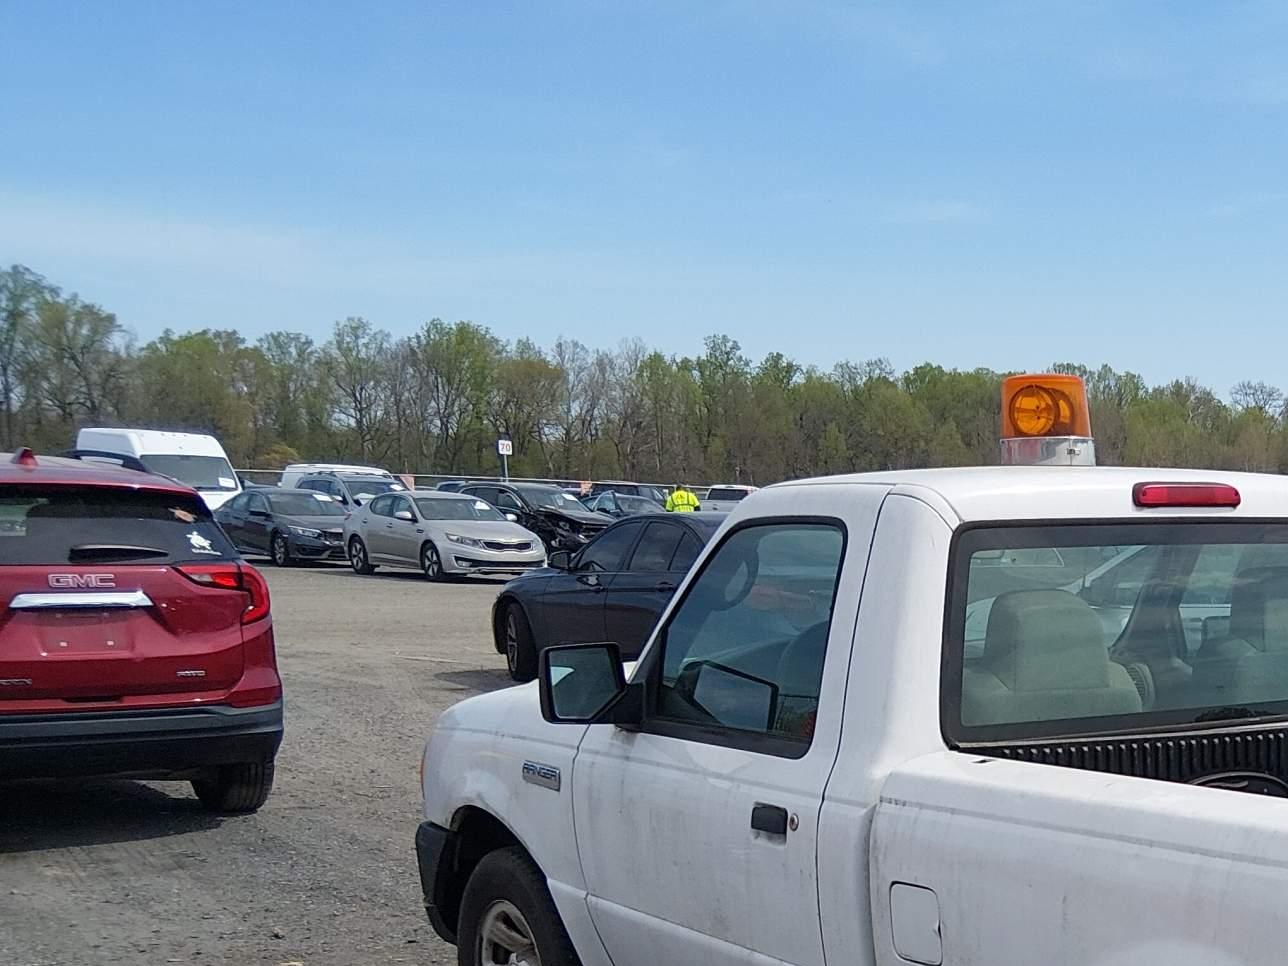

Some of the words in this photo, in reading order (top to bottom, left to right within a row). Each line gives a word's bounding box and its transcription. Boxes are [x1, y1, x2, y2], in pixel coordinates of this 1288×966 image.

[499, 442, 511, 452] 70
[48, 574, 116, 588] GMC
[523, 762, 558, 781] RANGER
